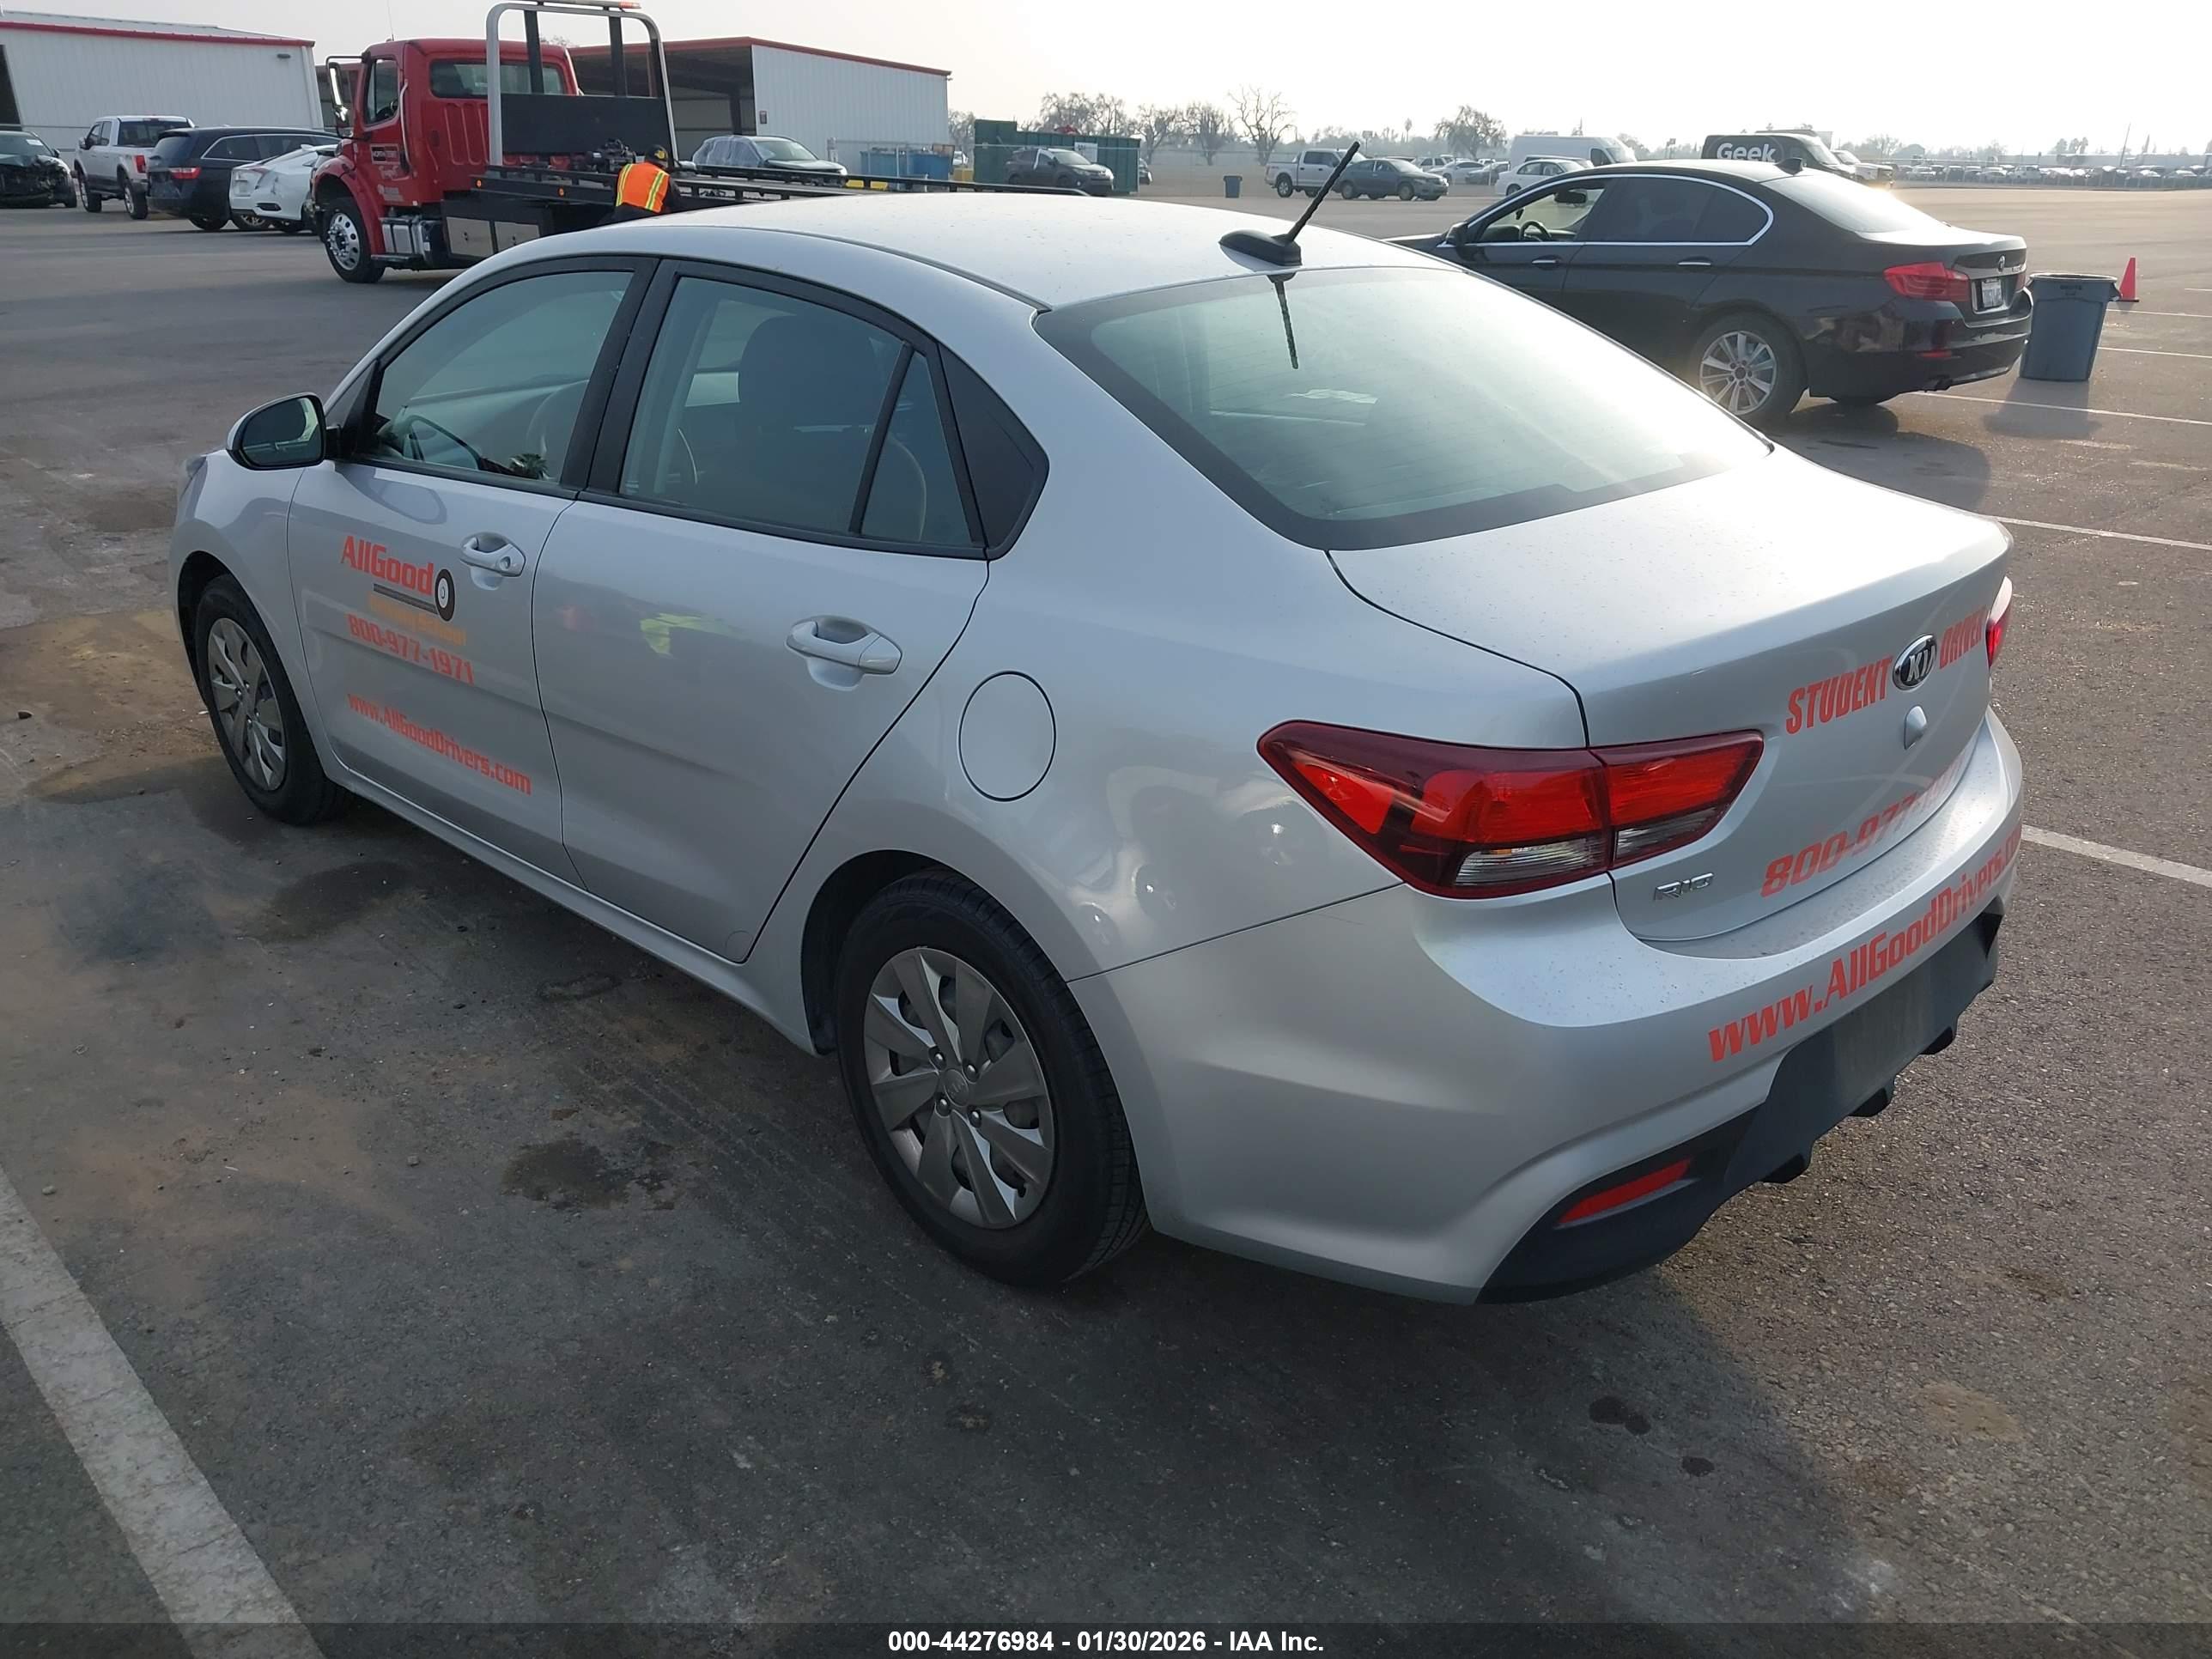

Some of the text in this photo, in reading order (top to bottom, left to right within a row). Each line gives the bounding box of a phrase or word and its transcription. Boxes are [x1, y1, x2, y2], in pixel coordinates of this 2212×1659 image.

[1717, 143, 1777, 162] Geek
[340, 534, 434, 597] AllGood
[347, 613, 474, 686] 800-977-1971
[1906, 641, 1936, 683] KIA
[1786, 654, 1893, 735] STUDENT
[347, 694, 532, 796] www.AllGoodDrivers.com
[1653, 872, 1714, 902] RIO
